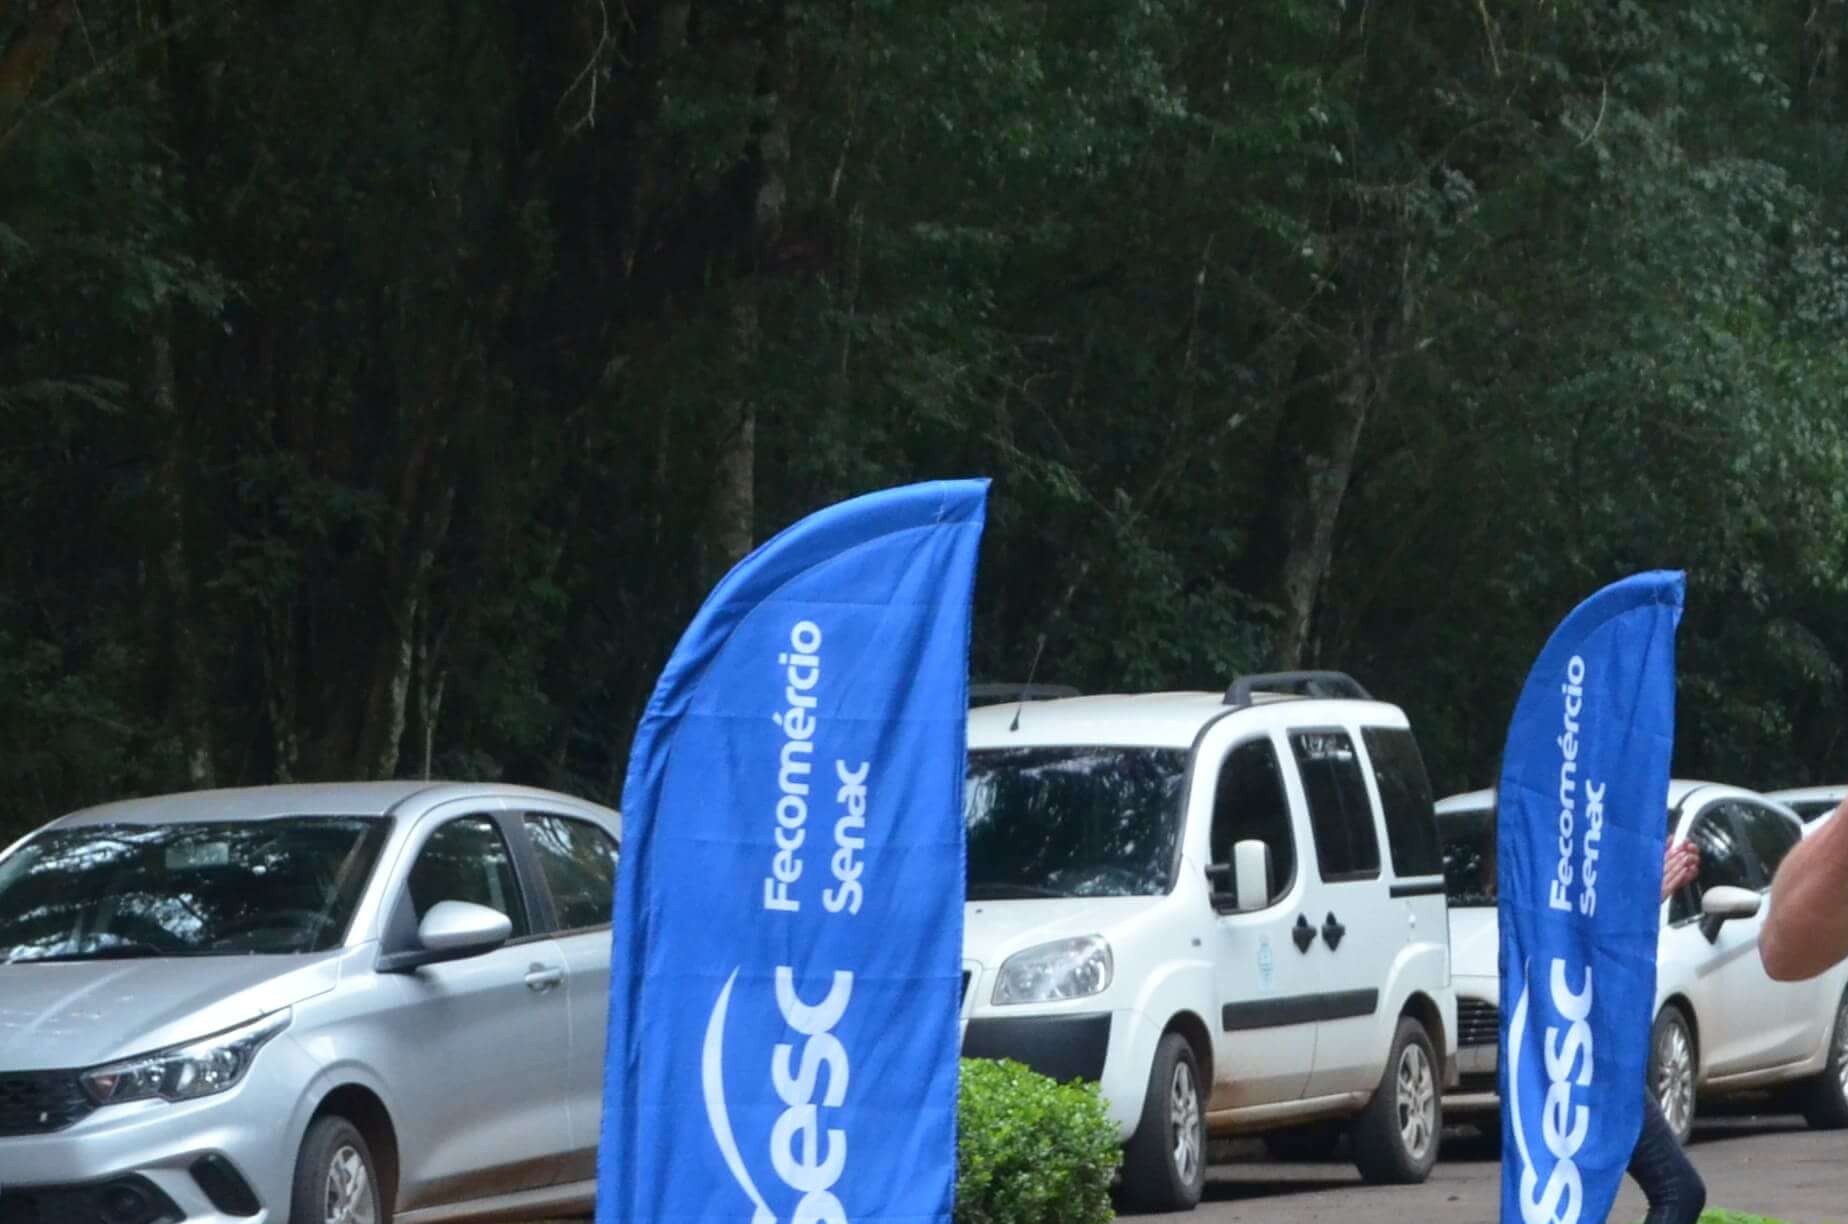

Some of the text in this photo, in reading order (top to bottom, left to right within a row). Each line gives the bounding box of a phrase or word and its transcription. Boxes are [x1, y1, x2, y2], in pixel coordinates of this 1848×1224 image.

[764, 620, 822, 912] Fecomércio
[823, 760, 870, 915] Senac
[1549, 655, 1585, 912] Fecomércio
[1580, 780, 1605, 917] Senac
